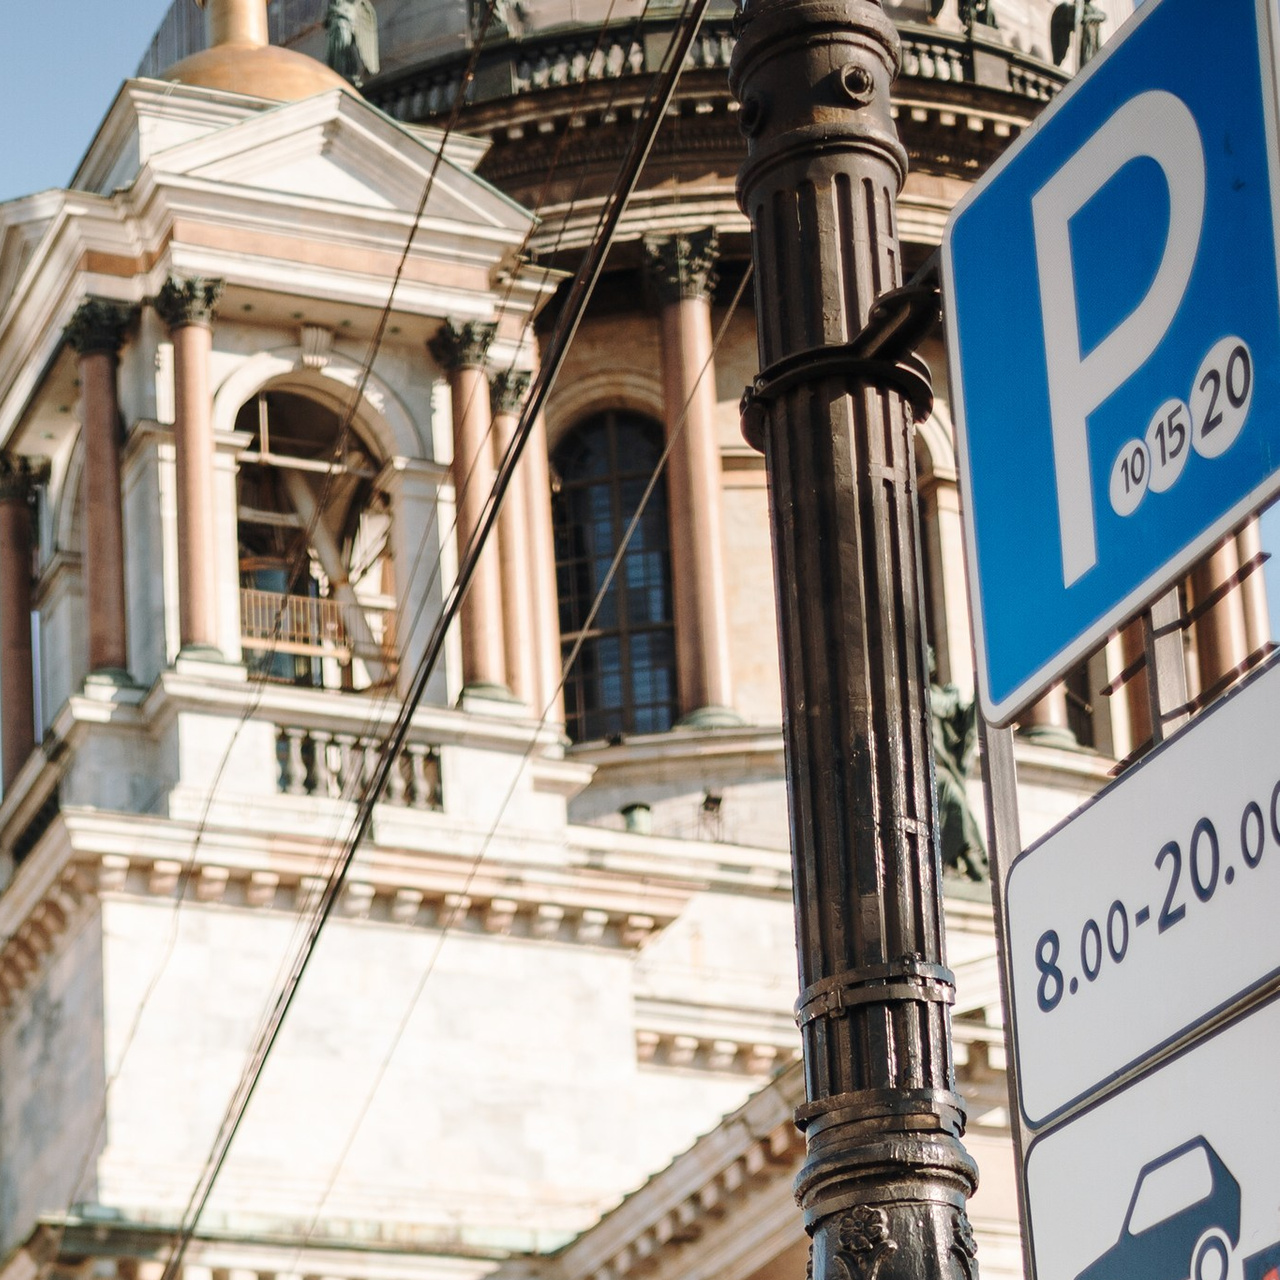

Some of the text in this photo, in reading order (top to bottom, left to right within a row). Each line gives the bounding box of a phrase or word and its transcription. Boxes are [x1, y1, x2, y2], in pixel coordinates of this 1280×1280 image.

[1032, 90, 1205, 589] P
[1121, 345, 1251, 494] 10 15 20
